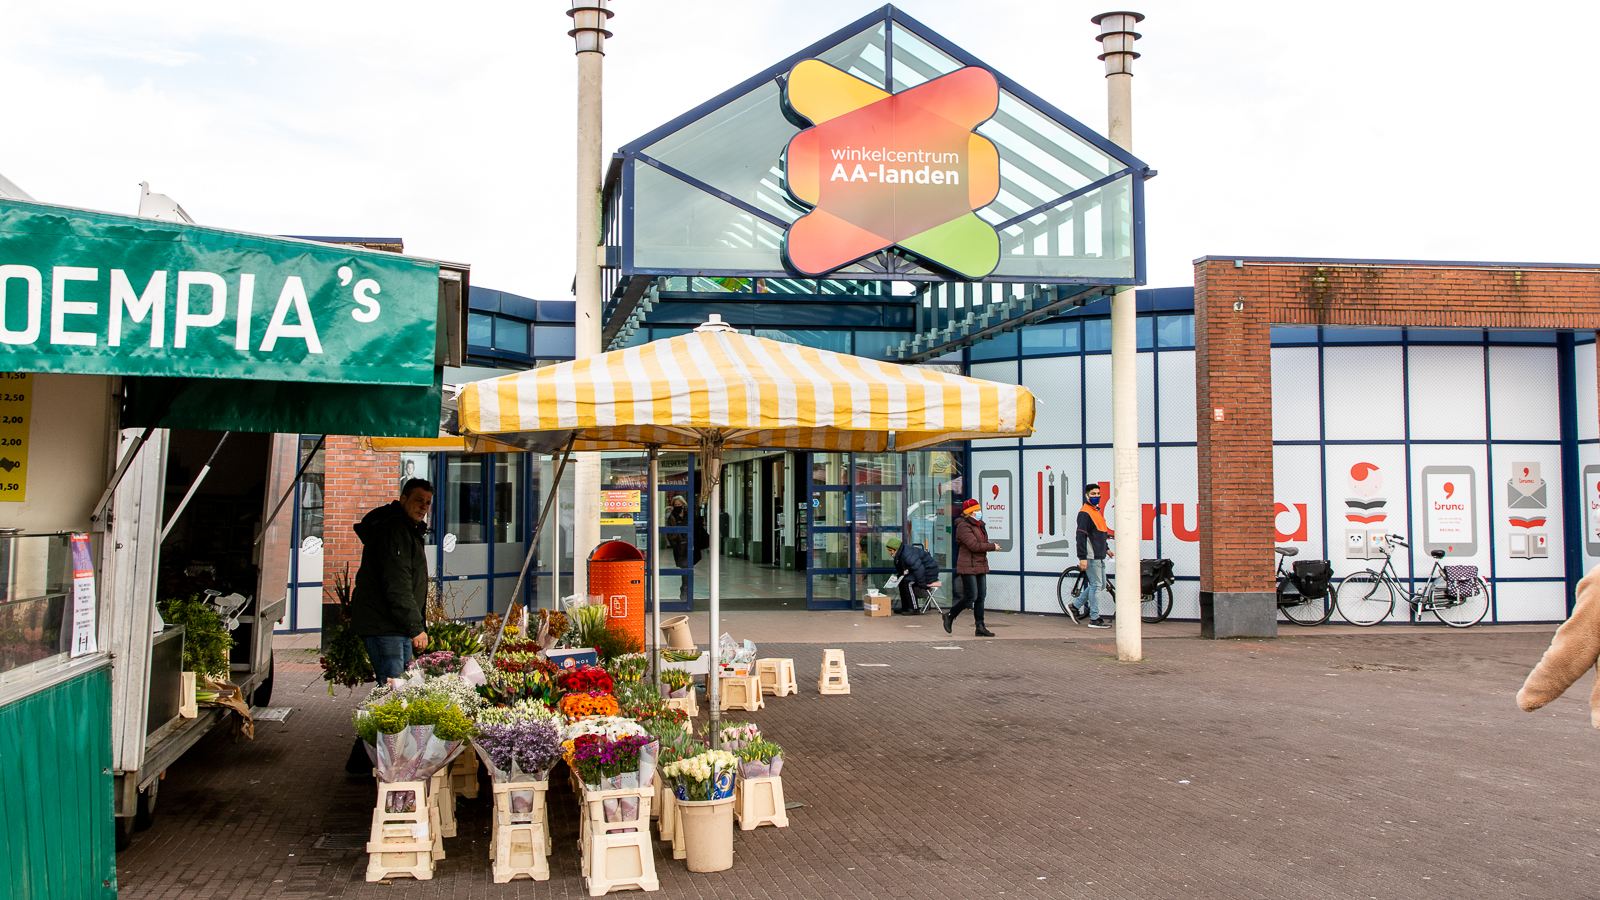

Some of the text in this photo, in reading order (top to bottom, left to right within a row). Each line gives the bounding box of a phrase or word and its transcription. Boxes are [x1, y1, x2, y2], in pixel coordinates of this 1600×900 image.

[831, 146, 958, 164] winkelcentrum
[830, 164, 959, 185] AA-landen
[4, 394, 25, 403] 2,50
[2, 416, 23, 425] 2,00
[1, 438, 22, 447] 2,00
[986, 501, 1006, 511] bruna
[1434, 501, 1464, 511] bruna
